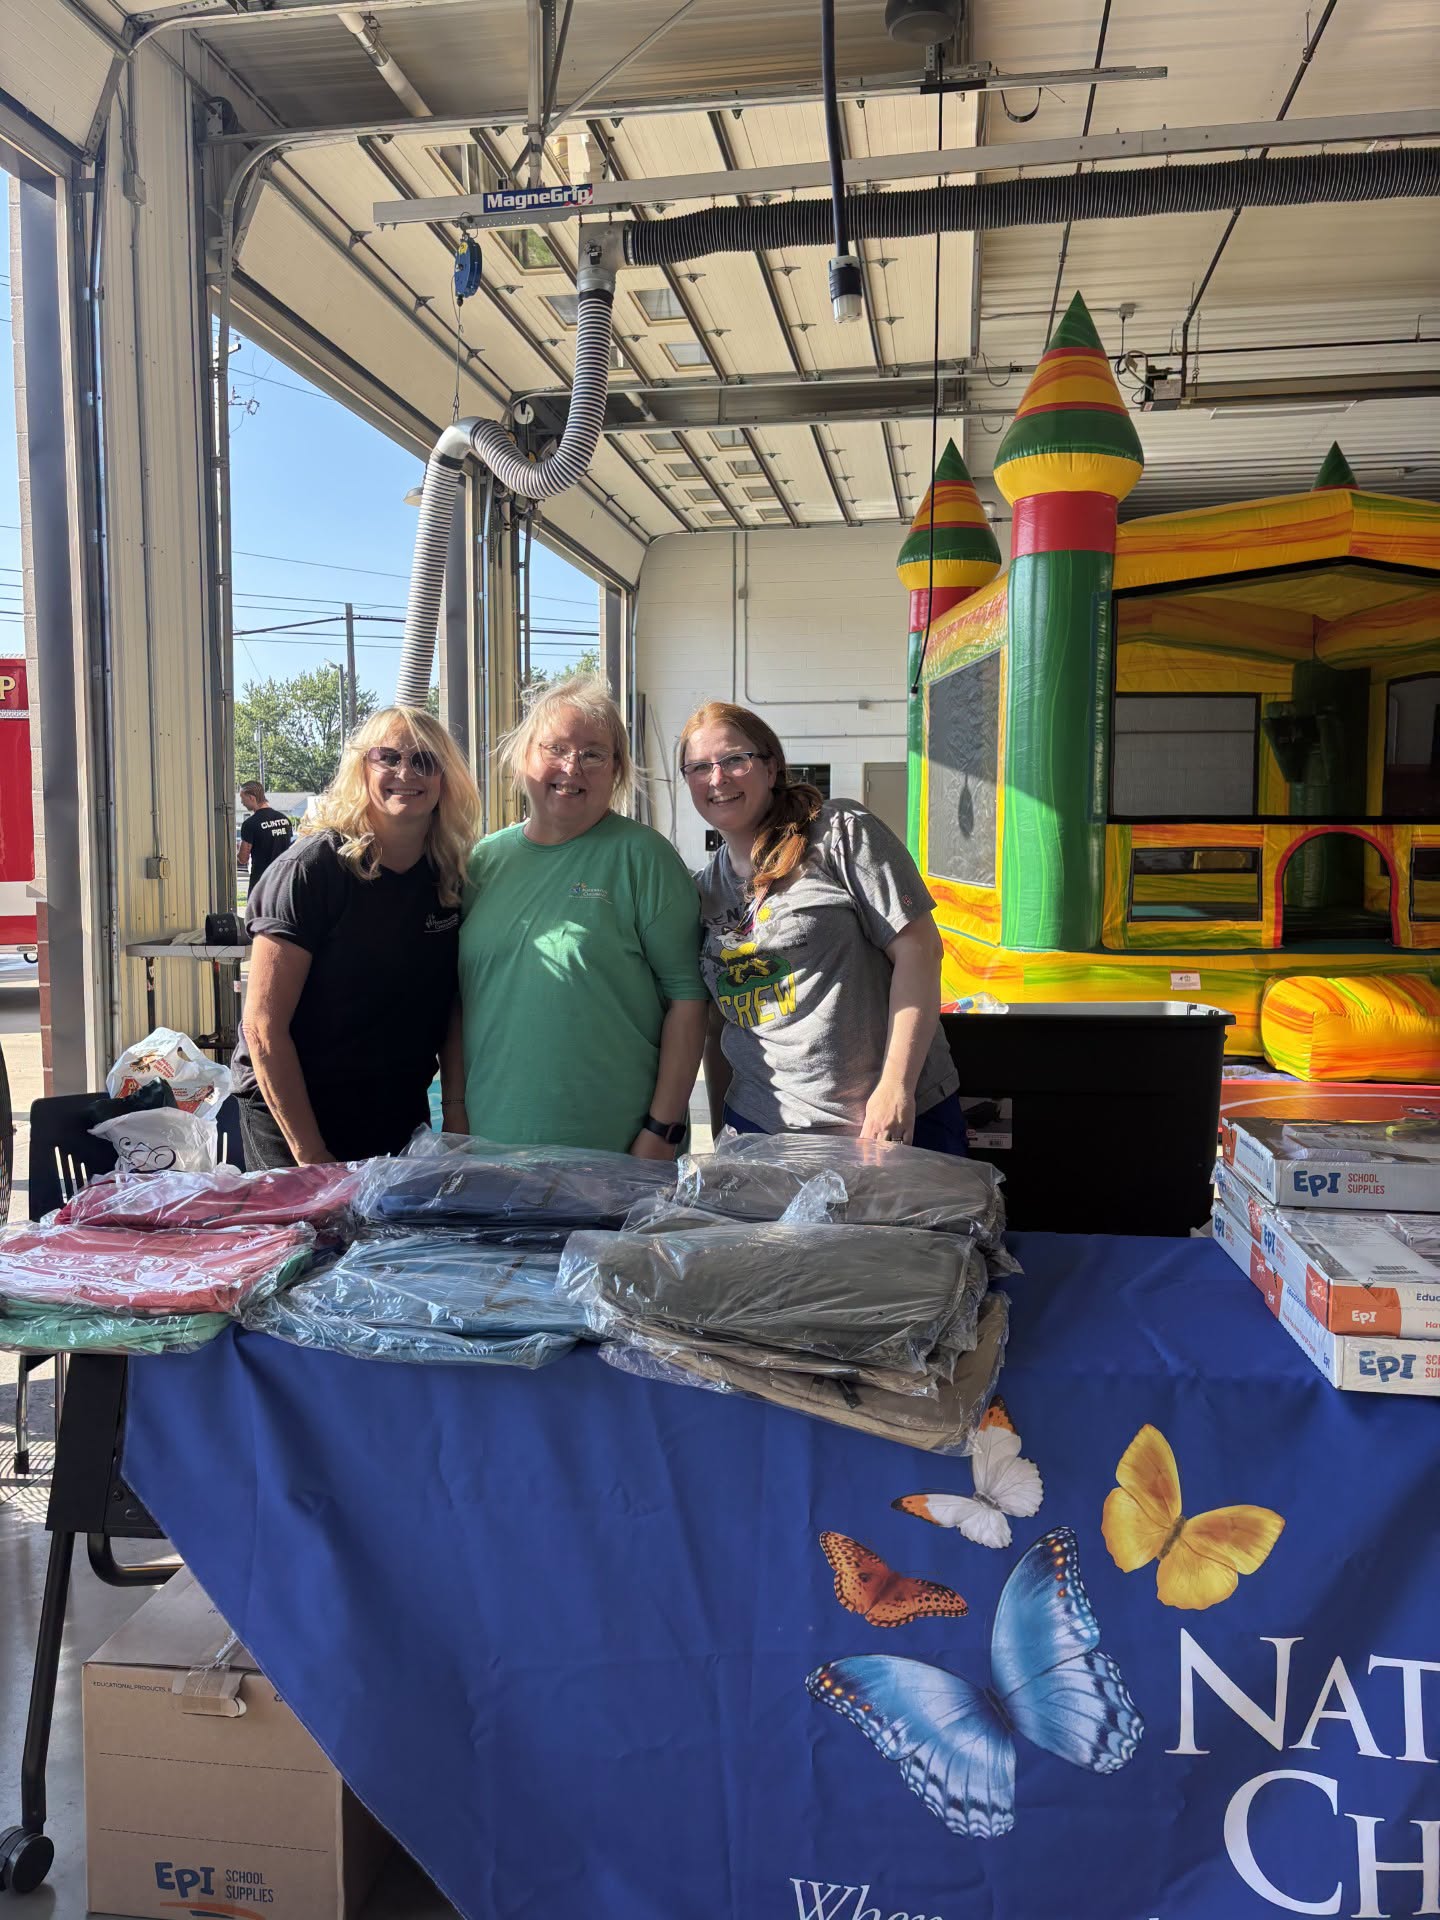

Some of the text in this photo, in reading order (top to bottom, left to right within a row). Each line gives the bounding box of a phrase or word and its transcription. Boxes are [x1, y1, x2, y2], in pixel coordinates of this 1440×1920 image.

[487, 185, 589, 209] MagneGrip
[260, 818, 290, 829] CLINTON
[271, 828, 287, 837] FIRE
[718, 972, 798, 1029] CREW
[1347, 1173, 1379, 1183] SCHOOL
[1347, 1184, 1385, 1195] SUPPLIES
[1425, 1321, 1440, 1329] Ha
[93, 1681, 134, 1690] EDUCATIONAL
[1164, 1628, 1440, 1763] NAT
[1223, 1769, 1440, 1919] CH
[225, 1869, 266, 1885] SCHOOL
[225, 1885, 274, 1903] SUPPLIES
